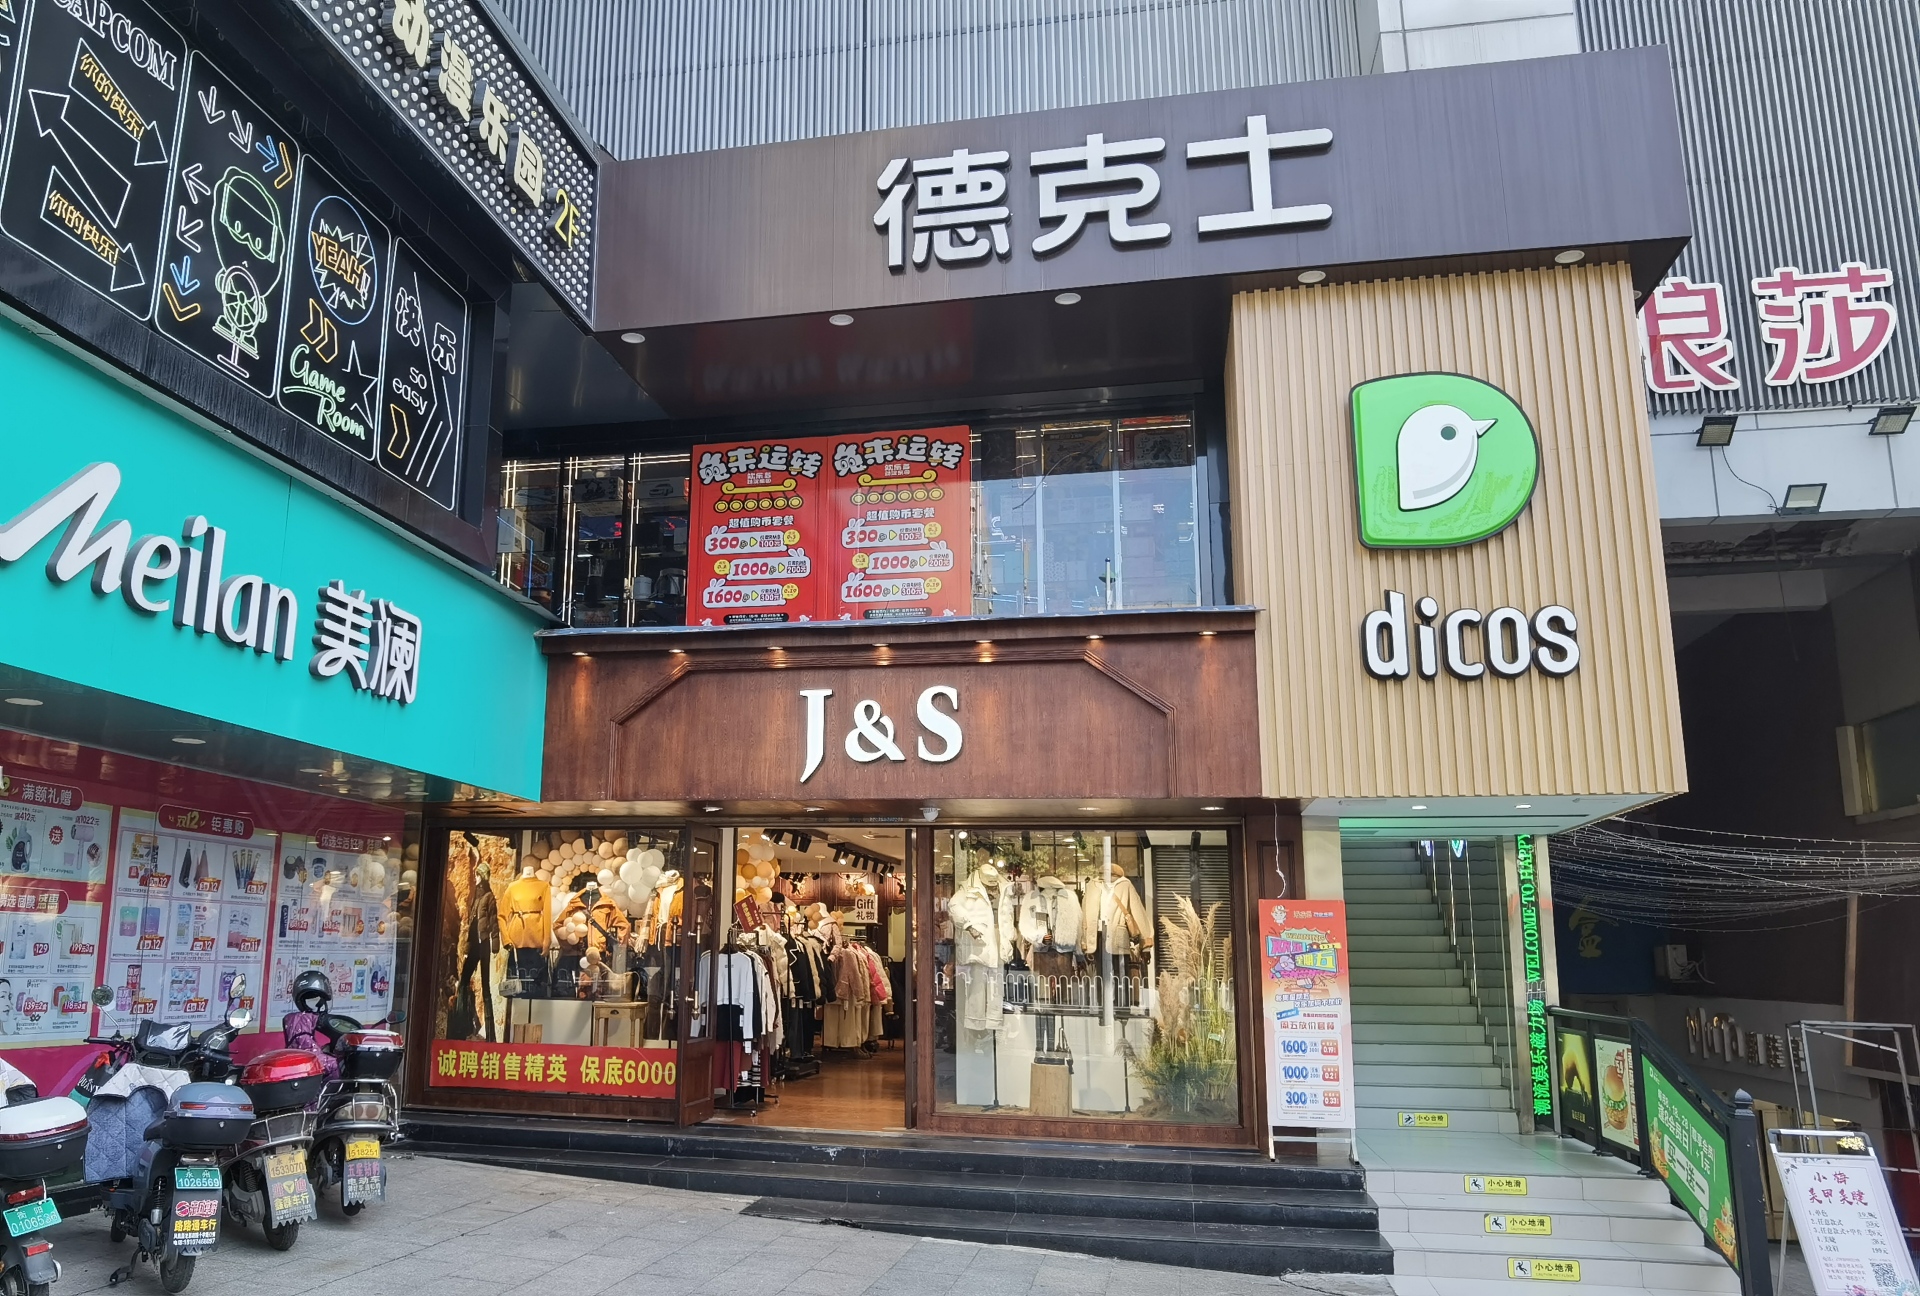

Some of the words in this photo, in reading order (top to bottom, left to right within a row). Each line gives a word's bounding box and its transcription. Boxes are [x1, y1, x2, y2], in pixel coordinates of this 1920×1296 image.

[53, 0, 177, 91] APCOM
[873, 114, 1334, 272] 德克士
[554, 188, 581, 251] 2F
[290, 344, 346, 402] Game
[409, 367, 427, 389] so
[393, 378, 428, 415] easy
[317, 395, 366, 440] Room
[709, 537, 740, 552] 300
[845, 529, 877, 545] 300
[0, 462, 298, 662] Meilan
[733, 562, 768, 576] 1000
[872, 556, 909, 570] 1000
[706, 589, 742, 603] 1600
[845, 584, 882, 598] 1600
[311, 579, 422, 705] 美澜
[1361, 588, 1580, 681] dicos
[21, 783, 73, 807] 满额礼赠
[1521, 883, 1535, 904] TO
[857, 899, 874, 909] Gift
[856, 911, 874, 921] 礼物
[1523, 907, 1541, 983] WELCOME
[1281, 1040, 1307, 1054] 1600
[438, 1049, 568, 1084] 诚聘销售精英
[580, 1055, 676, 1086] 保底6000
[1282, 1065, 1309, 1080] 1000
[1285, 1091, 1308, 1105] 300
[1667, 1139, 1706, 1194] 买一送一
[178, 1178, 220, 1188] 1026569
[1487, 1179, 1521, 1188] 小心地滑
[1510, 1218, 1546, 1227] 小心地滑
[1534, 1262, 1573, 1273] 小心地滑
